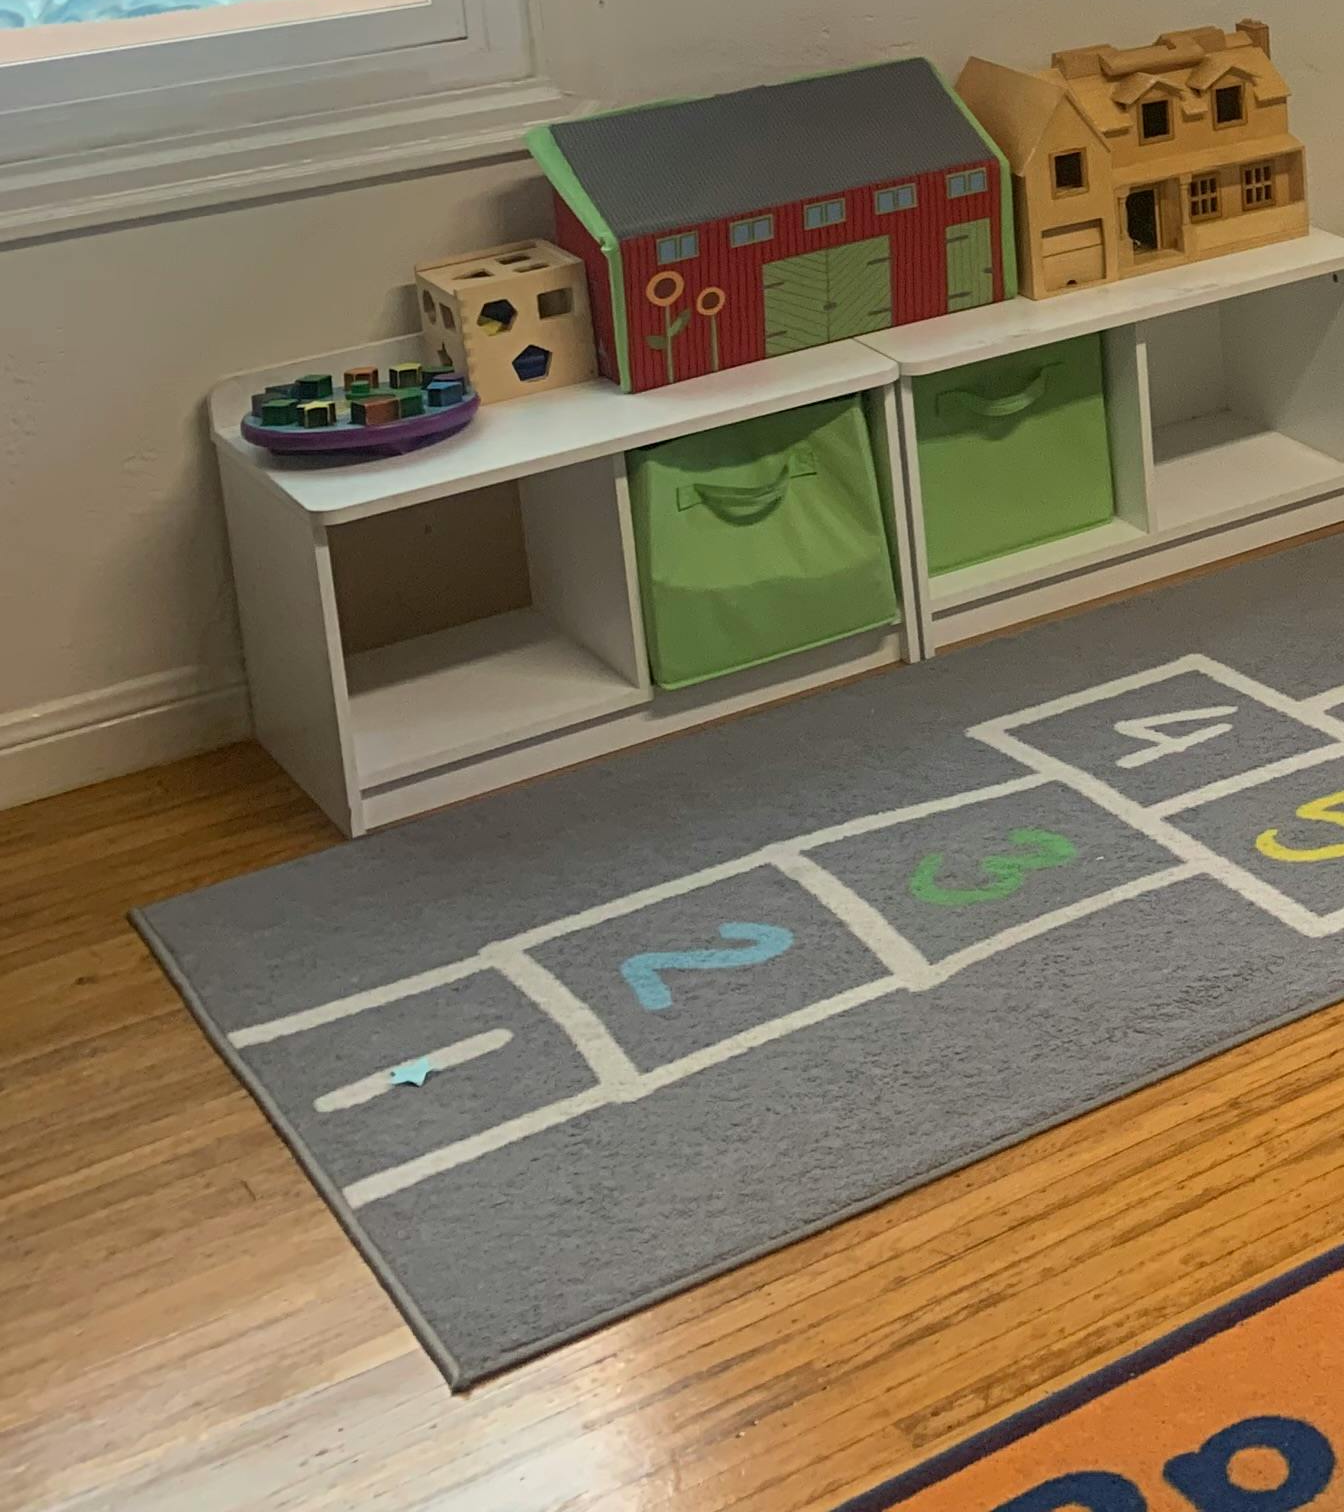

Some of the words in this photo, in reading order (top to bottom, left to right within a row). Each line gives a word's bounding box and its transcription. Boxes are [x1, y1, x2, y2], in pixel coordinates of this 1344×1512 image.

[1112, 705, 1239, 769] 4
[909, 827, 1078, 906] 3
[619, 921, 794, 1011] 2
